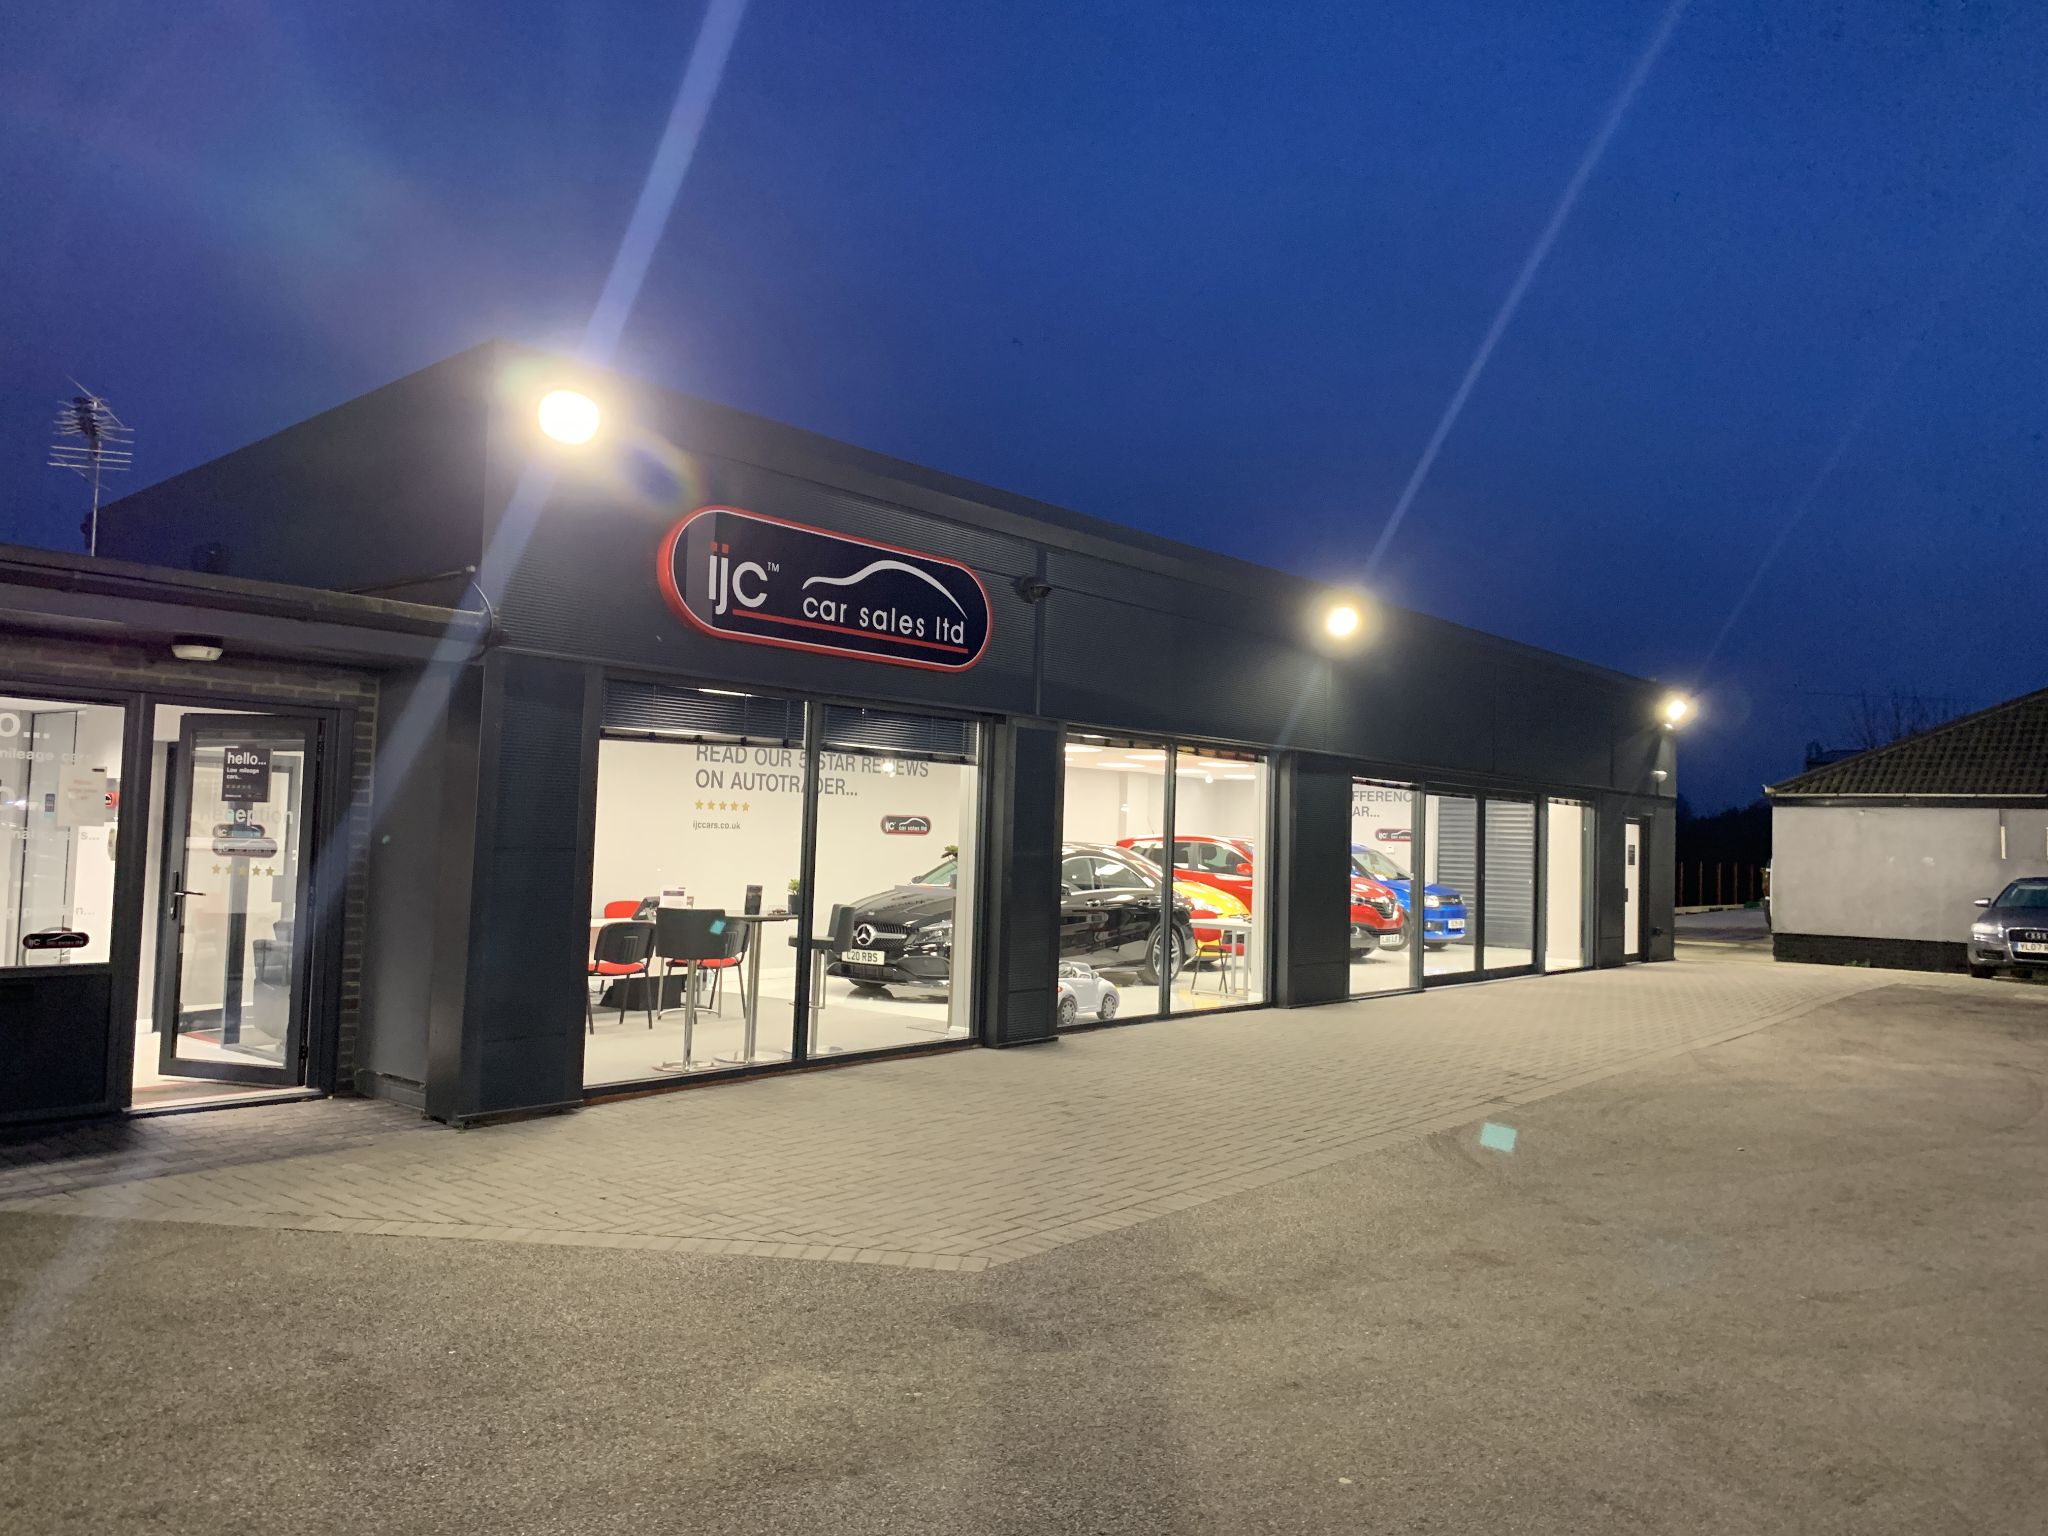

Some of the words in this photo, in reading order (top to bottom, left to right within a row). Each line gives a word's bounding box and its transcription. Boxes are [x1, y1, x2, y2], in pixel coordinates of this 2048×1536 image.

[708, 541, 768, 615] ijc
[802, 596, 848, 624] car
[859, 607, 925, 639] sales
[936, 616, 964, 645] ltd
[227, 752, 266, 765] hello...
[696, 745, 747, 763] READ
[754, 748, 792, 768] OUR
[819, 753, 854, 771] STAR
[696, 769, 724, 789] ON
[692, 819, 741, 830] ijccars.co.uk
[862, 952, 878, 963] RBS
